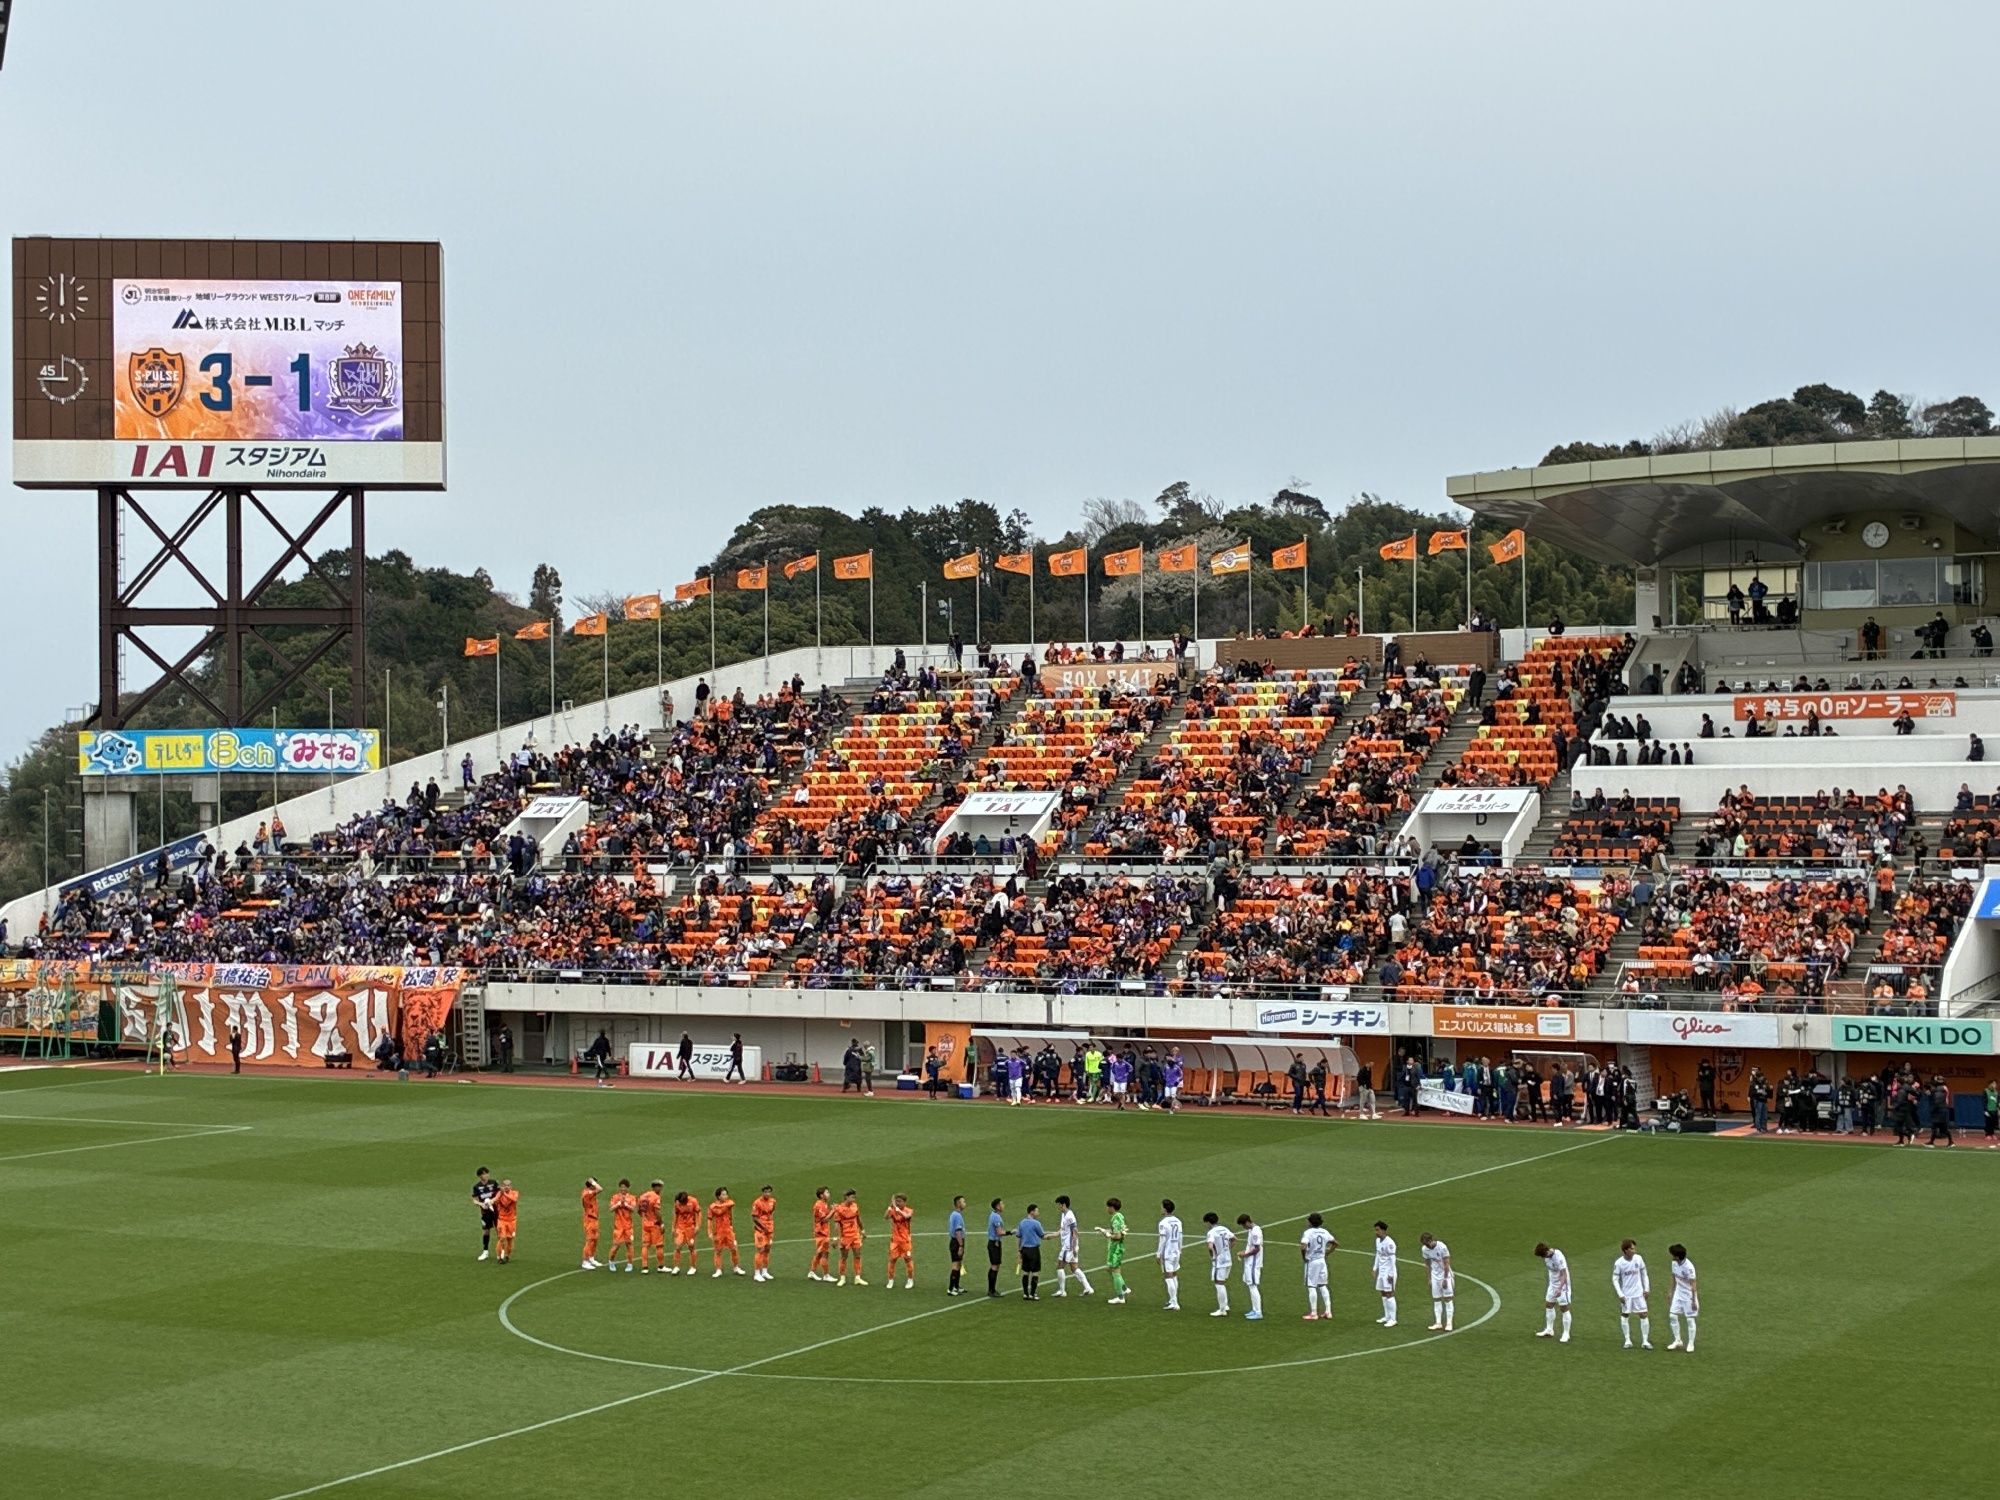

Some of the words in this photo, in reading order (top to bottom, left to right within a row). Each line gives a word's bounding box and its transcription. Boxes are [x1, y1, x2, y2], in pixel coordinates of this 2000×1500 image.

[260, 293, 312, 301] WESTグループ
[348, 290, 365, 300] ONE
[367, 290, 396, 300] FAMILY
[205, 317, 261, 330] 株式会社
[264, 317, 312, 331] M.B.L
[313, 320, 345, 331] マッチ
[40, 365, 56, 376] 45
[199, 353, 232, 411] 3
[290, 353, 310, 411] 1
[131, 445, 215, 477] IAI
[225, 447, 327, 466] スタジアム
[266, 469, 327, 478] Nihondaira
[1063, 670, 1097, 687] BOX
[1763, 696, 1919, 716] 鈴与の0円ソーラー
[209, 732, 276, 767] 8ch
[293, 738, 356, 763] みてね
[1457, 793, 1496, 802] IAI
[984, 802, 1026, 812] IAI
[1436, 802, 1511, 811] パラスポーツパーク
[1010, 815, 1019, 827] E
[1476, 813, 1487, 825] D
[92, 863, 145, 892] RESPET
[277, 966, 332, 986] JELANI
[111, 988, 389, 1061] SHIMIZU
[1302, 1009, 1381, 1027] シーチキン
[1439, 1020, 1535, 1034] エスパルス福祉基金
[1672, 1017, 1731, 1040] Glico
[1844, 1024, 1932, 1044] DENKI
[1941, 1027, 1982, 1046] DO
[1316, 1235, 1323, 1250] 9
